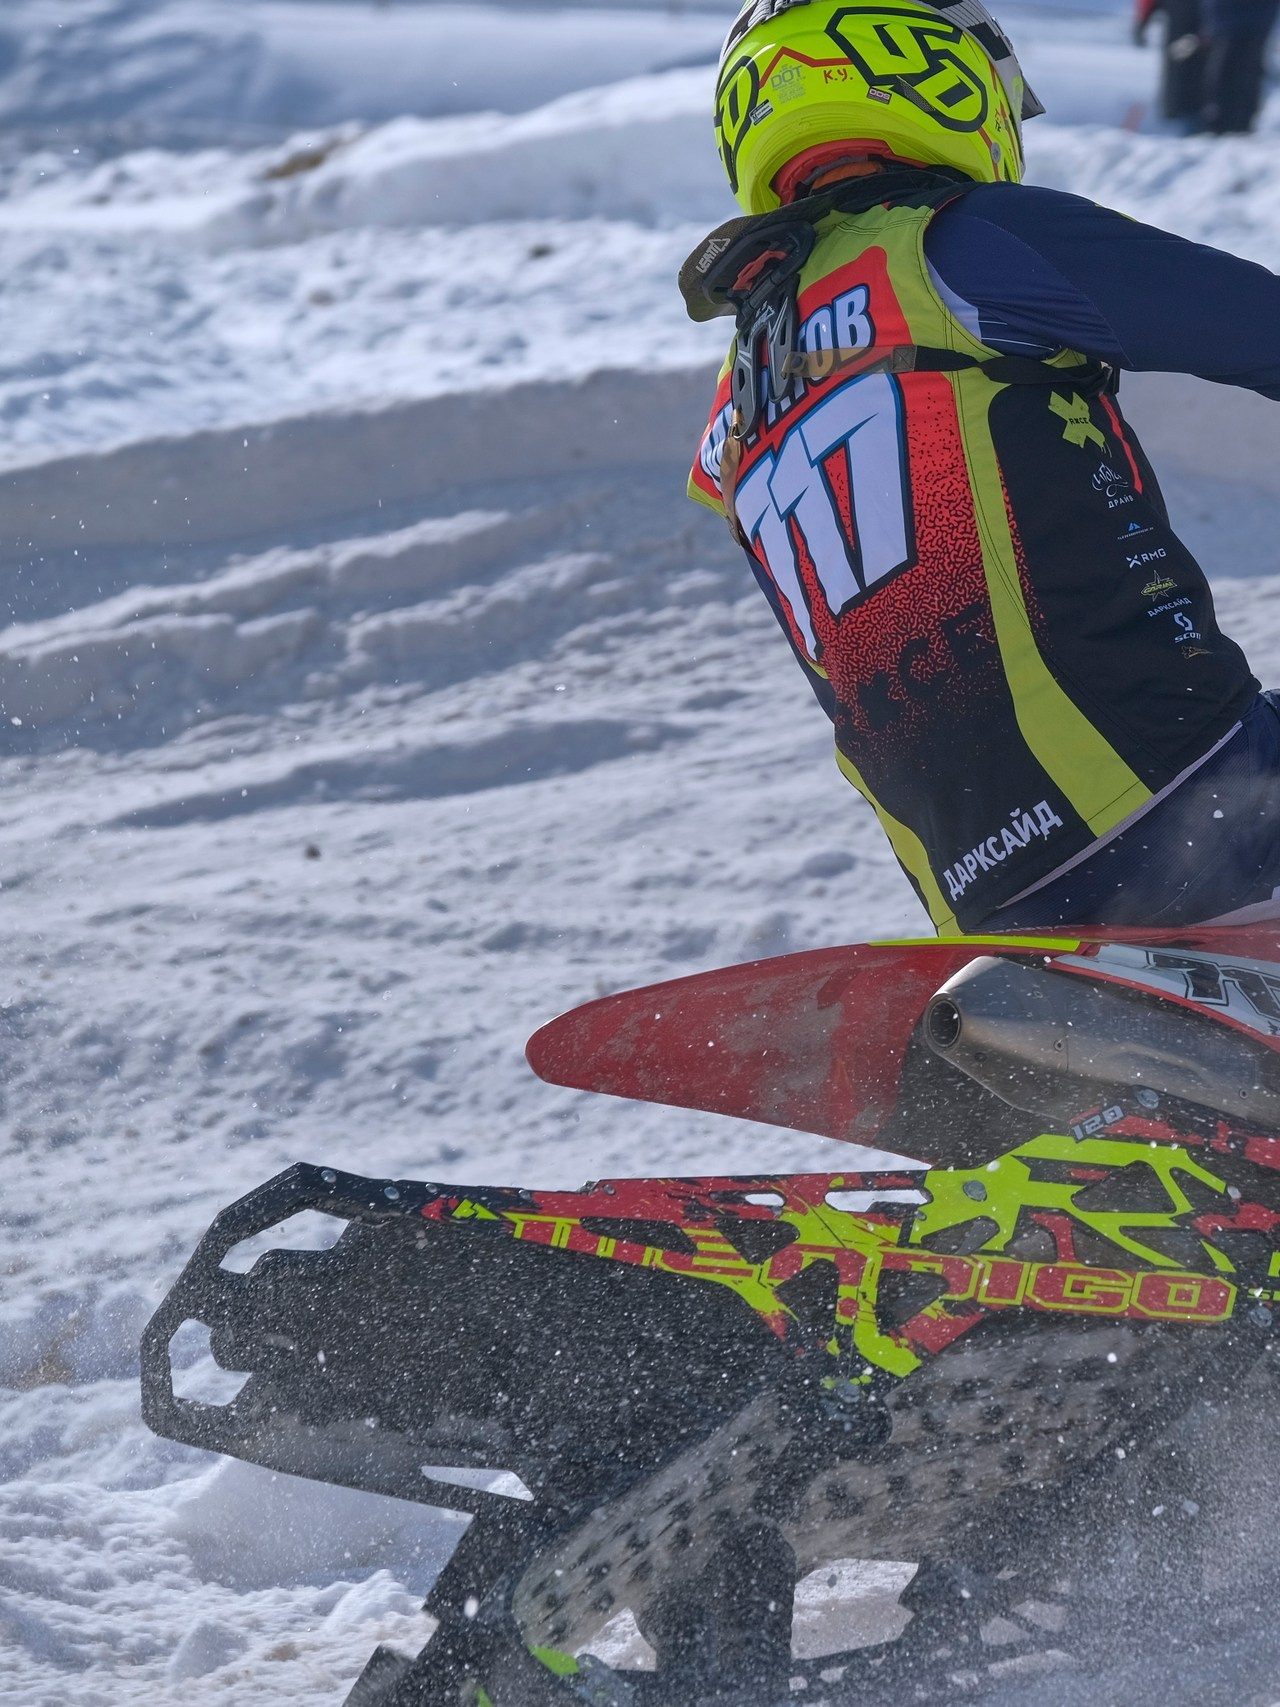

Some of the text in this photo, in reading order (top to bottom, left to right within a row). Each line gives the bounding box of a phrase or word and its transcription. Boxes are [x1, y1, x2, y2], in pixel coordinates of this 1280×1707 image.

[1107, 494, 1134, 509] ДРАЙВ
[1140, 548, 1167, 562] RMG
[1147, 597, 1192, 618] ДАРКСАЙД
[943, 800, 1064, 901] ДАРКСАЙД
